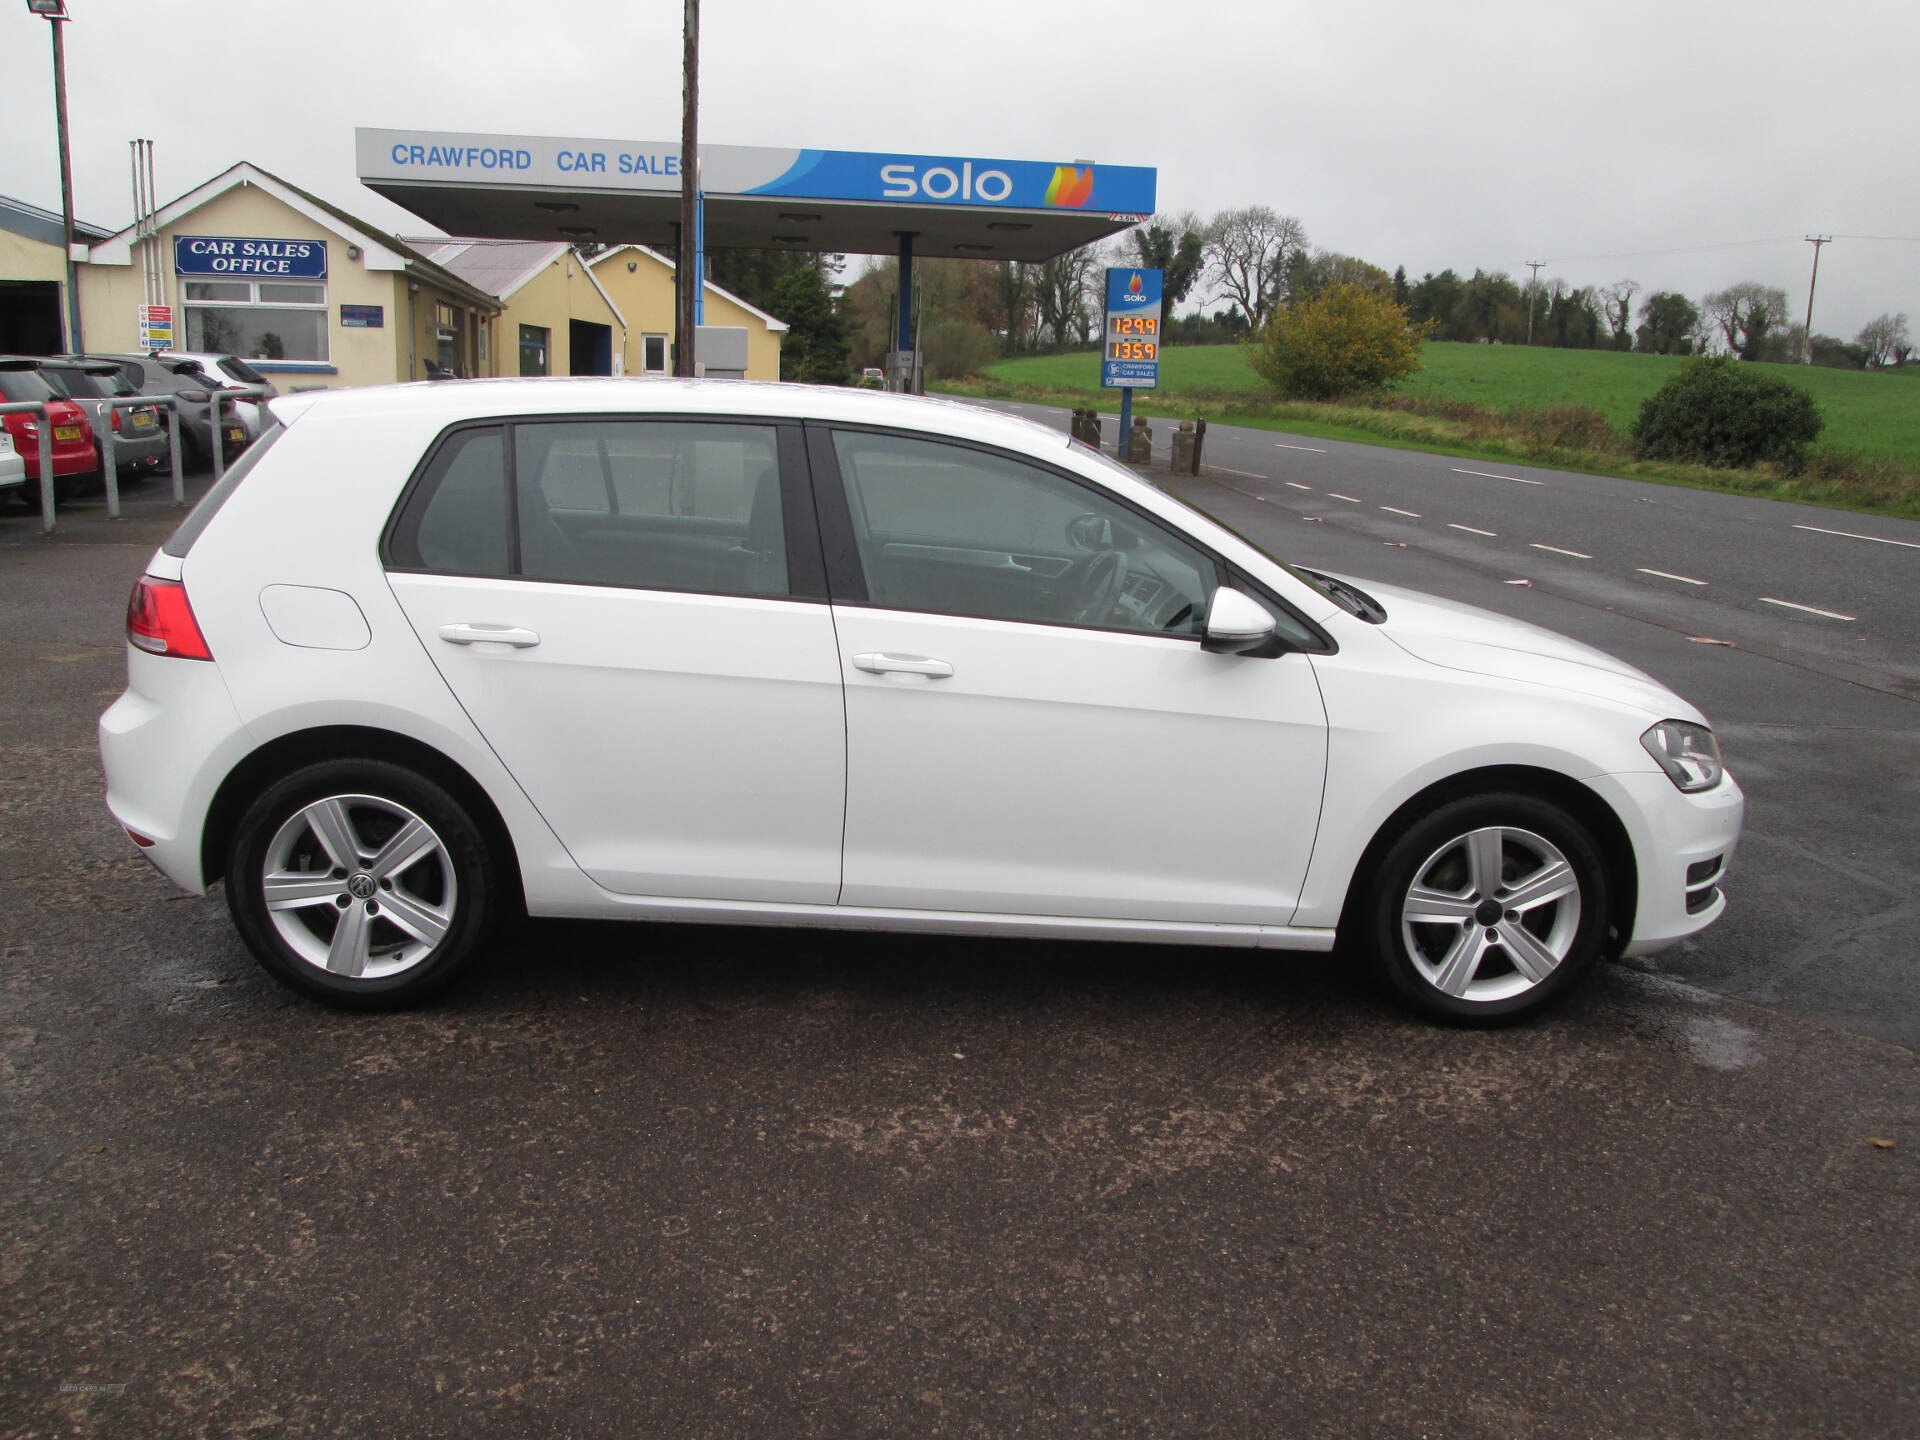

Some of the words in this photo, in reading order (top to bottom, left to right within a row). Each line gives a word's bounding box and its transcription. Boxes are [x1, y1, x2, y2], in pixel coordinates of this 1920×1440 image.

[391, 143, 531, 170] CRAWFORD
[557, 150, 606, 173] CAR
[880, 161, 1013, 202] solo
[191, 241, 235, 255] CAR
[242, 242, 311, 258] SALES
[212, 258, 291, 273] OFFICE
